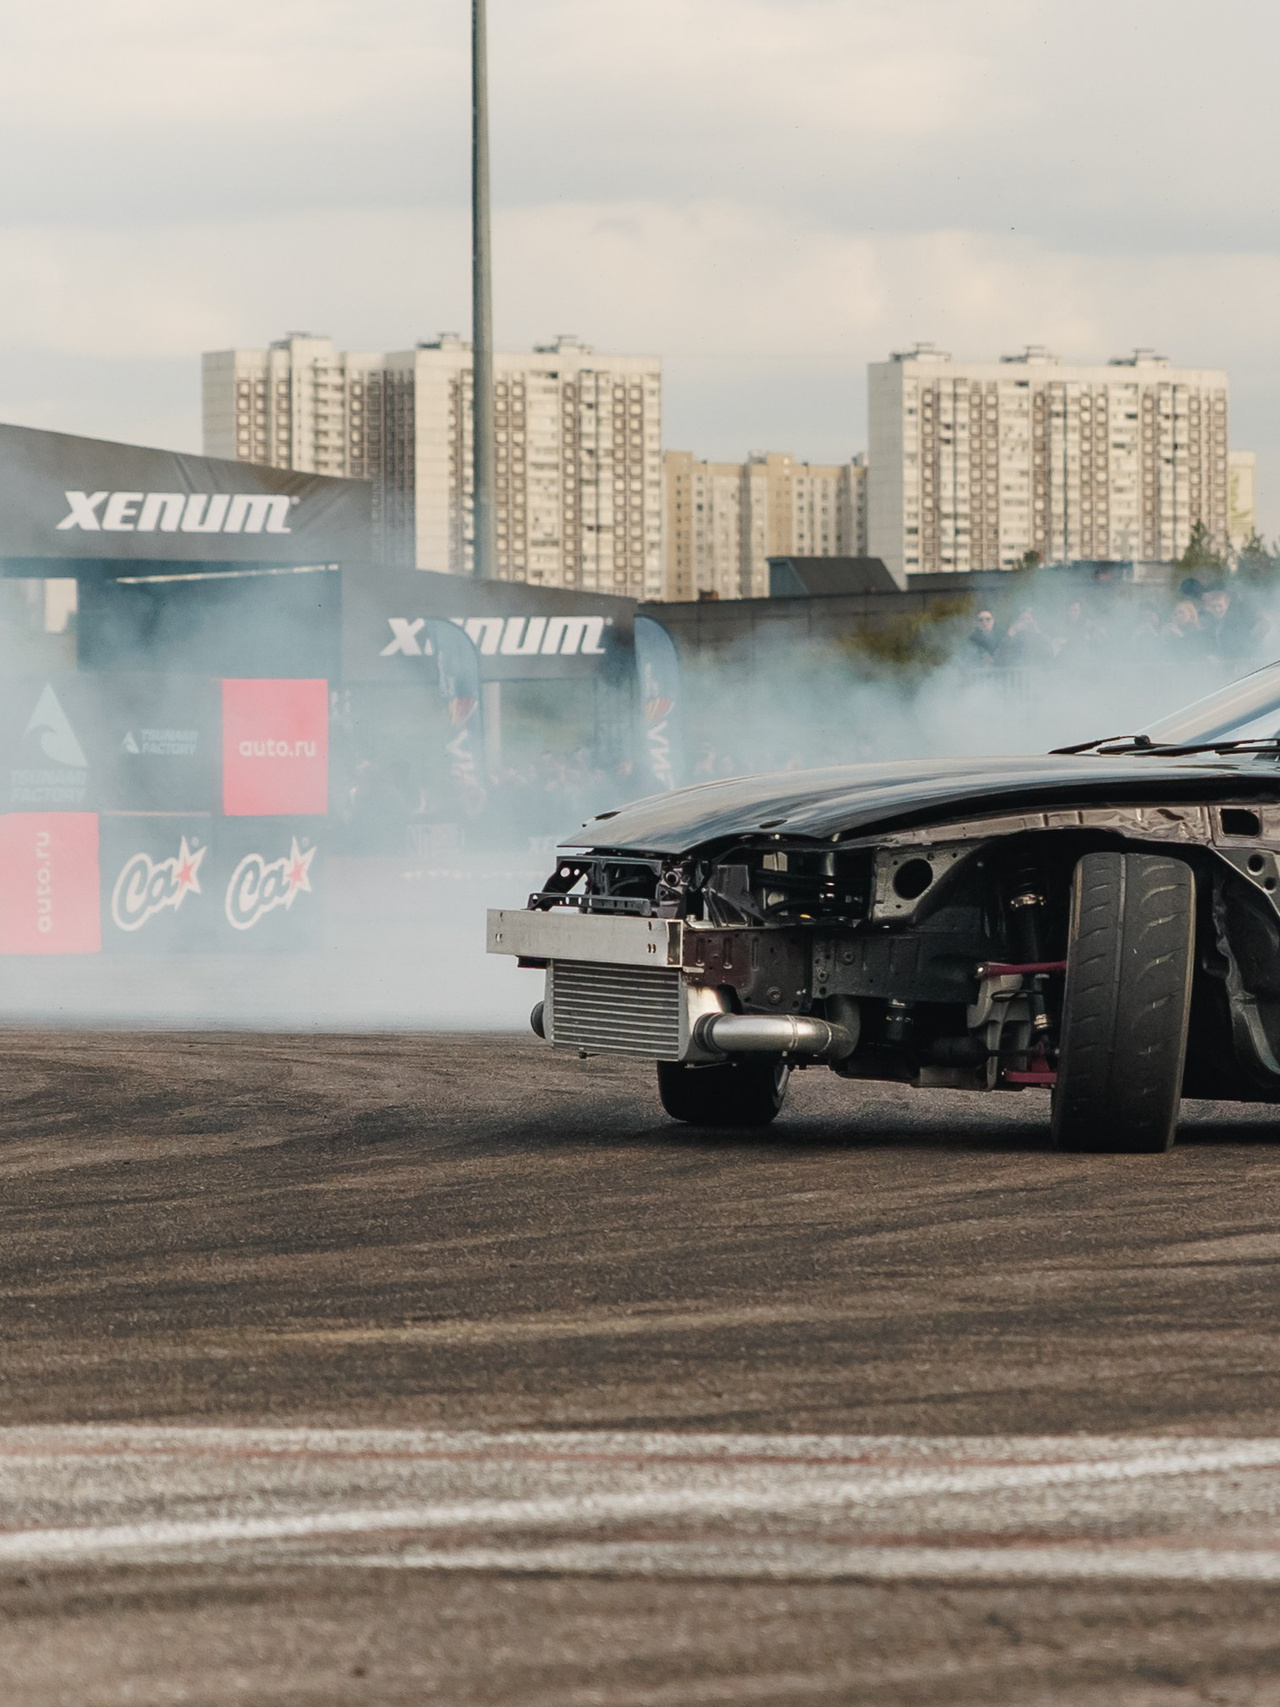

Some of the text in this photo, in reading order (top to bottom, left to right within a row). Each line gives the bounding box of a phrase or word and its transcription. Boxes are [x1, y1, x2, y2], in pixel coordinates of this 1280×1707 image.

[55, 490, 293, 534] XENUM
[379, 615, 606, 657] XNUM
[239, 738, 317, 758] auto.ru
[36, 830, 51, 934] auto.ru
